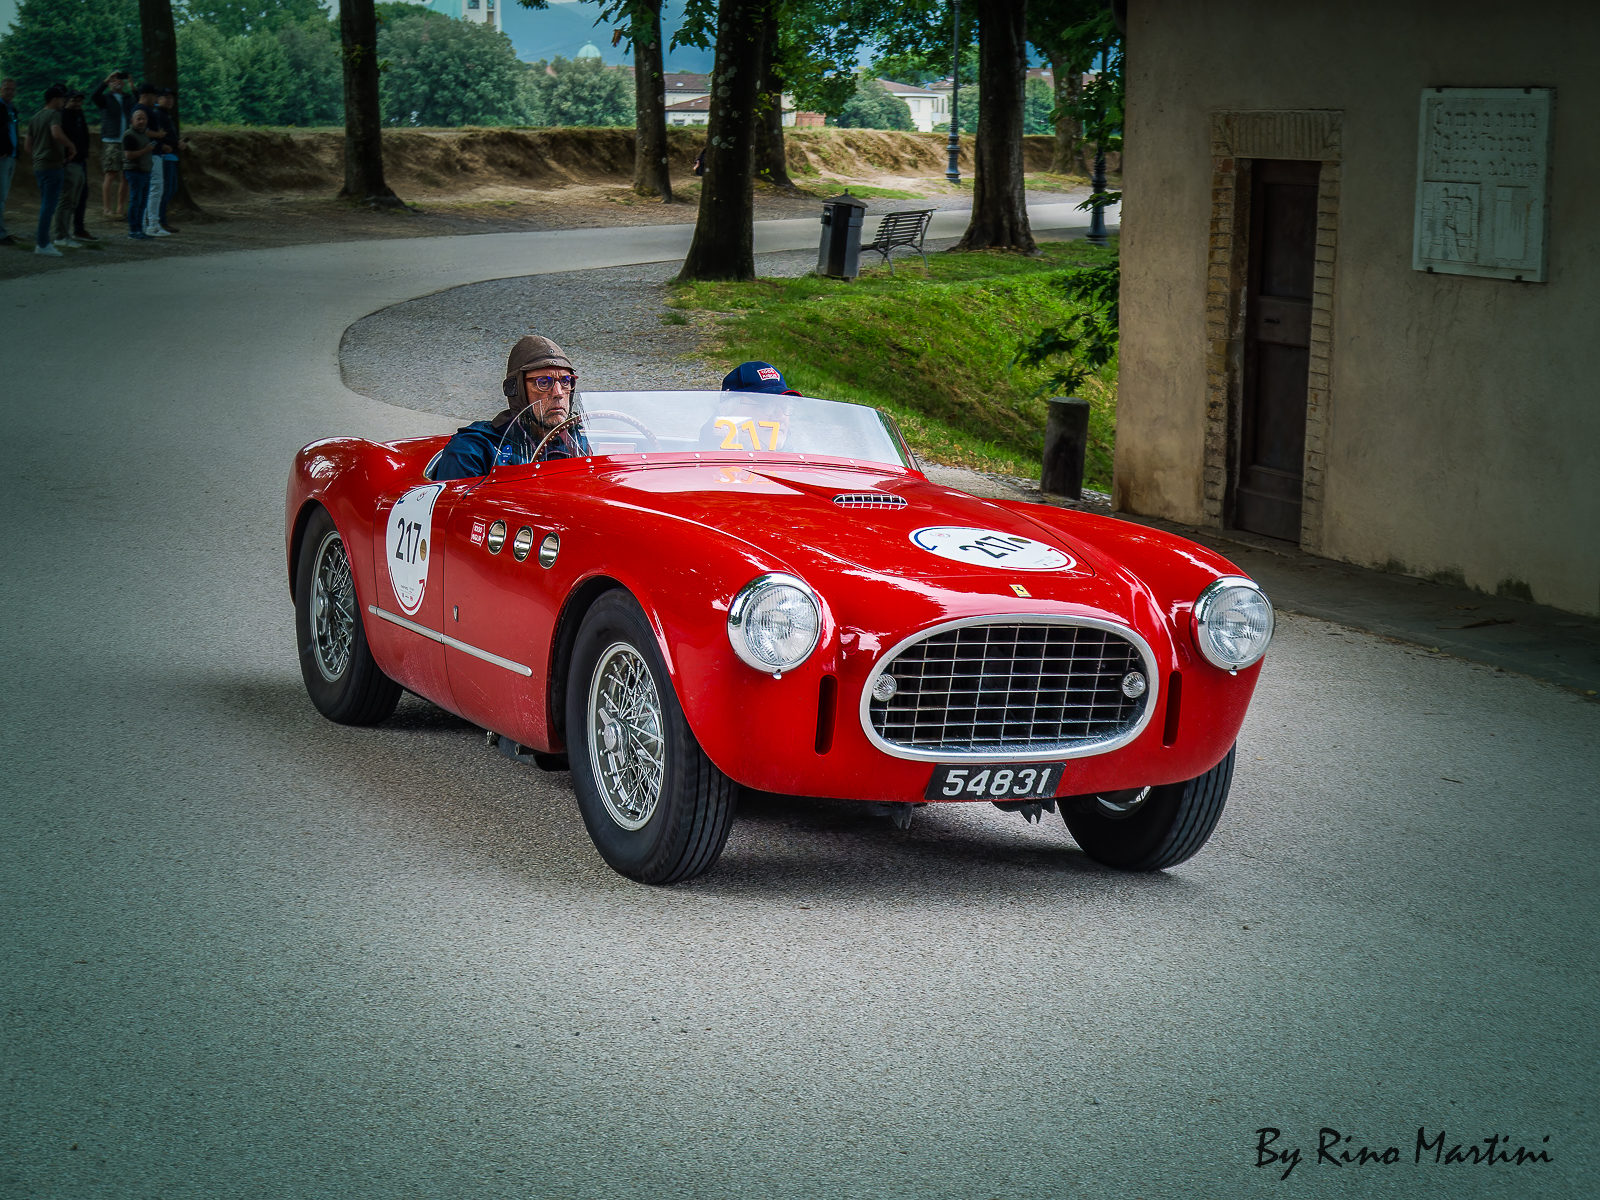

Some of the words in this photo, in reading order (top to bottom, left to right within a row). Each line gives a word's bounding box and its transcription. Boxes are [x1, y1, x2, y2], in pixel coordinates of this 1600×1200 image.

[714, 419, 780, 451] 217
[395, 517, 422, 565] 217
[958, 536, 1025, 559] 217
[942, 768, 1052, 796] 54831
